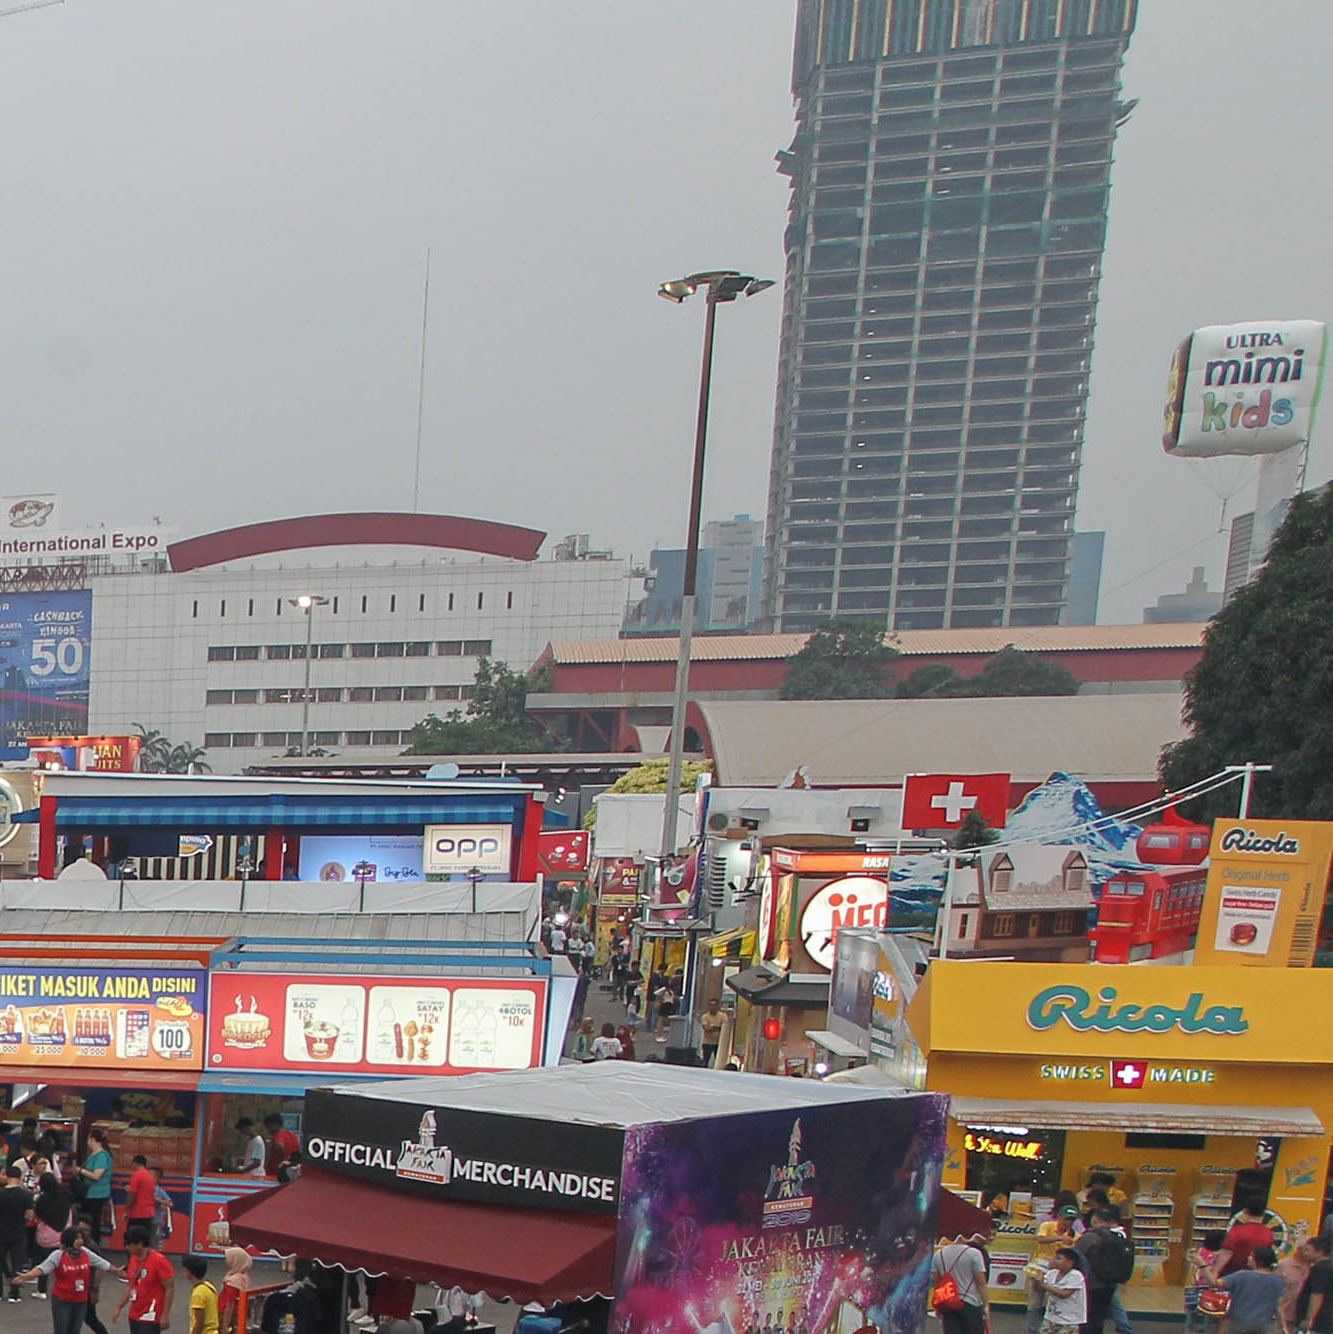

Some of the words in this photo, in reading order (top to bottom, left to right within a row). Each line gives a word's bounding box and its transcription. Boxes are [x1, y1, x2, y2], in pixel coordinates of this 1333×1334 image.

[1226, 332, 1284, 349] ULTRA
[1204, 348, 1305, 387] mimi
[1201, 388, 1295, 433] kids
[112, 533, 158, 550] Expo
[34, 610, 82, 623] CASHBACK
[30, 637, 84, 677] 50
[1220, 827, 1300, 855] Ricola
[862, 857, 889, 868] RASA
[40, 975, 103, 998] MASUK
[103, 977, 151, 999] ANDA
[152, 977, 197, 994] DISINI
[293, 1001, 316, 1009] BASO
[417, 1004, 444, 1012] SATAY
[1027, 984, 1250, 1035] Ricola
[159, 1028, 184, 1049] 100
[1040, 1063, 1105, 1080] SWISS
[1149, 1067, 1216, 1084] MADE
[308, 1138, 396, 1170] OFFICIAL
[453, 1158, 615, 1202] MERCHANDISE
[762, 1209, 812, 1229] 2019
[718, 1232, 801, 1262] JAKARTA
[805, 1224, 845, 1249] FAIR
